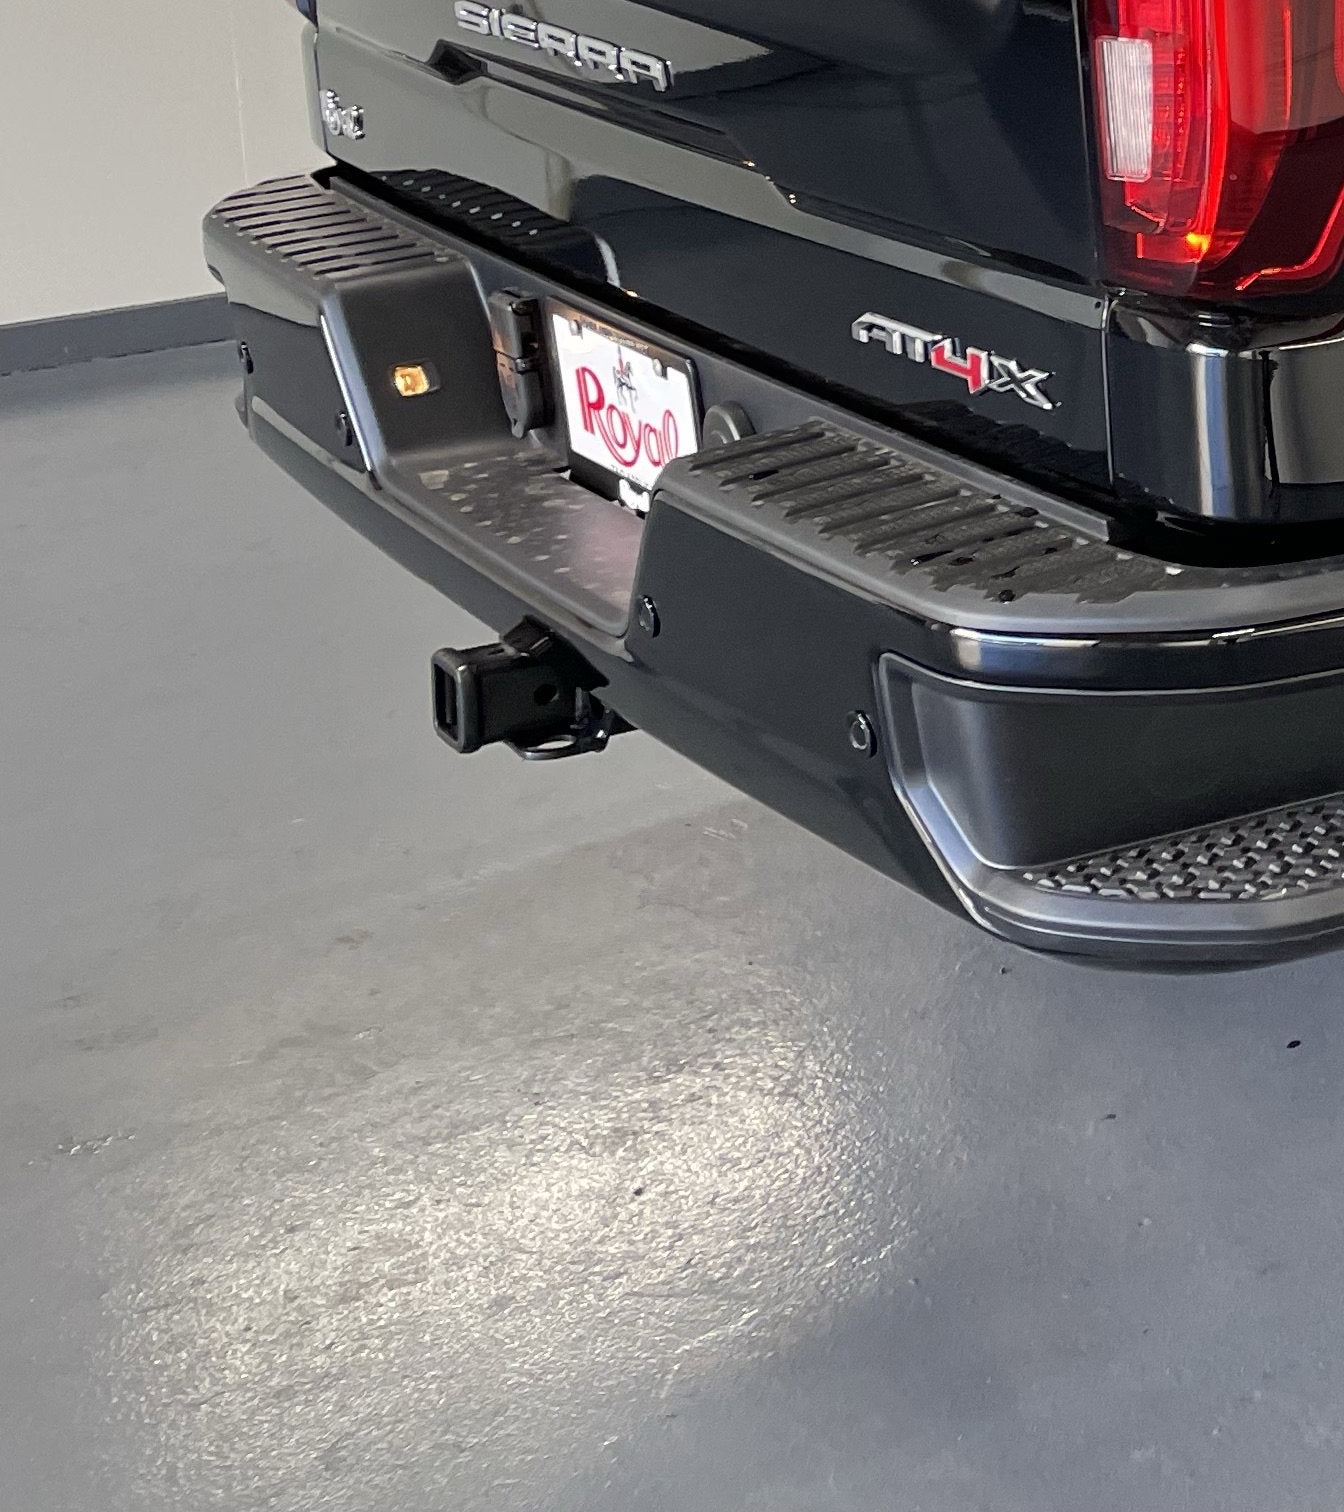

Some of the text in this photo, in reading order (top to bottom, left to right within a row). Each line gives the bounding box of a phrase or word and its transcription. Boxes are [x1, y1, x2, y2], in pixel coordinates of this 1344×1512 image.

[454, 0, 674, 92] SIERRA
[851, 311, 1060, 410] AT4X
[576, 366, 680, 468] Royal
